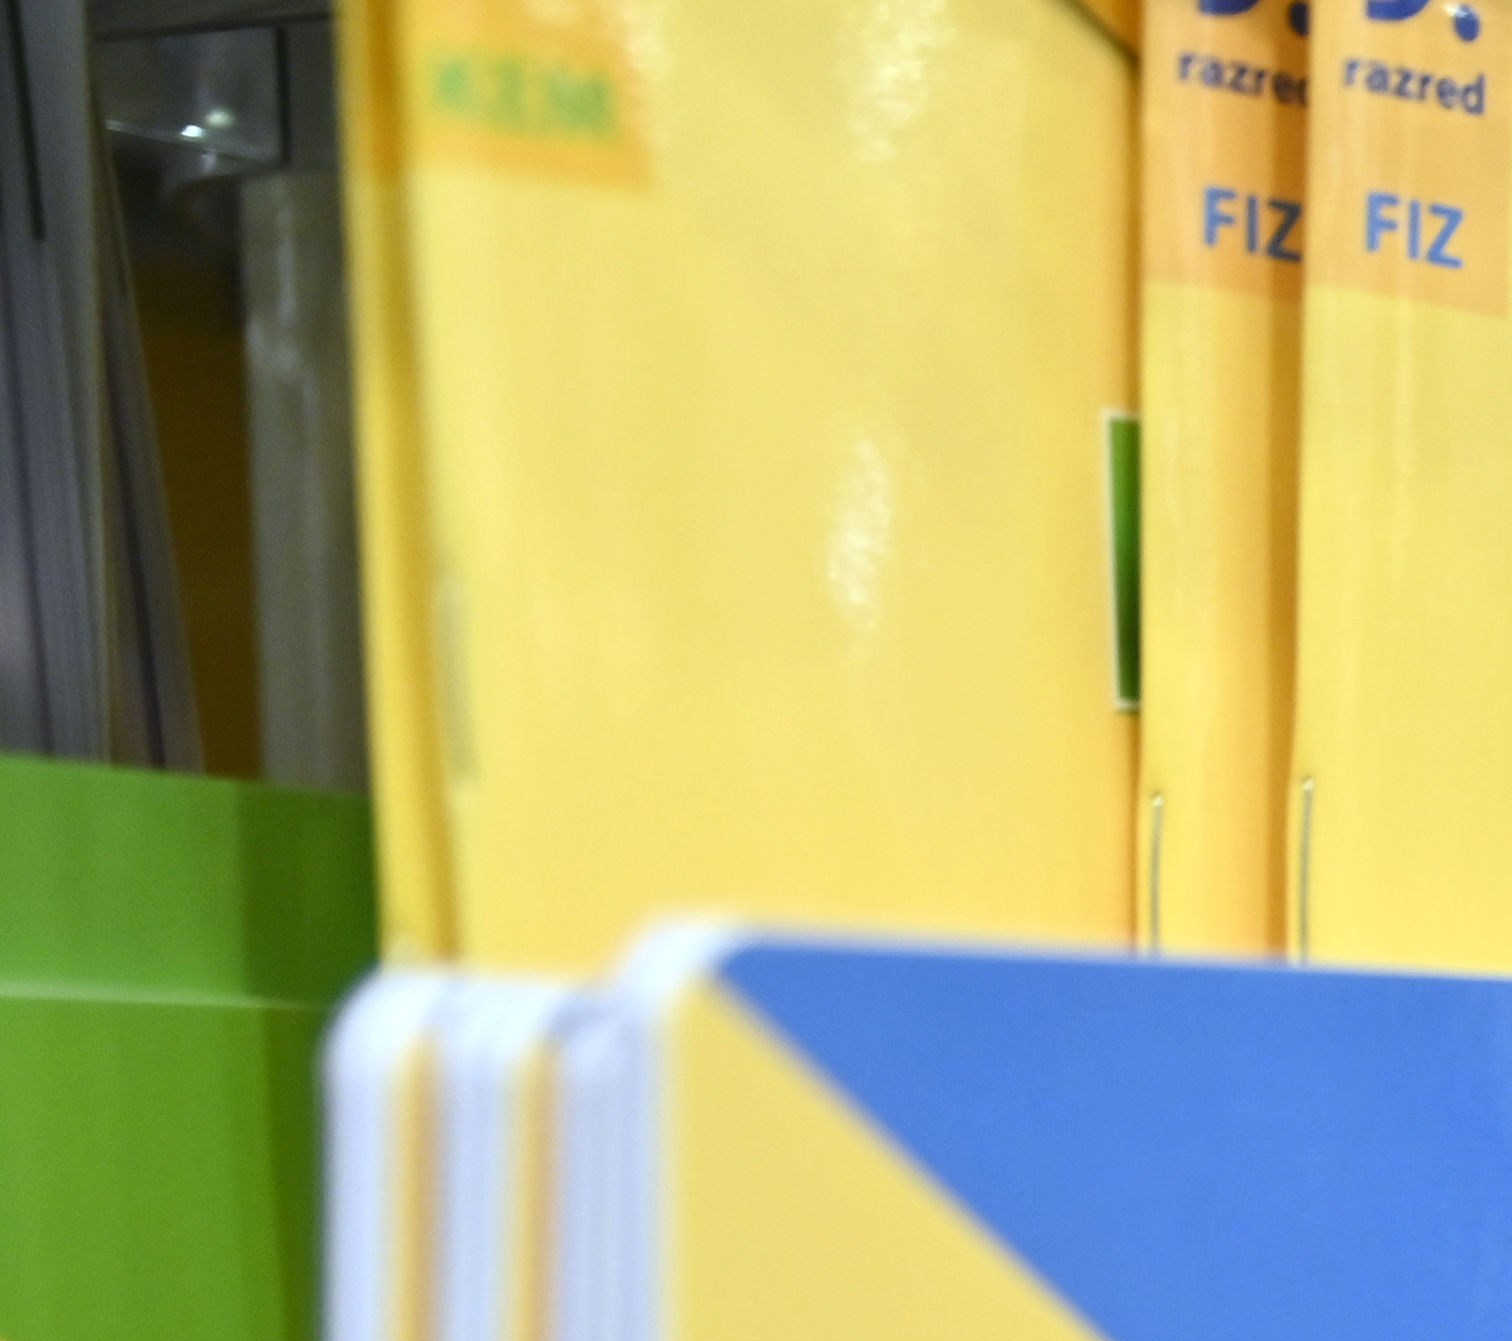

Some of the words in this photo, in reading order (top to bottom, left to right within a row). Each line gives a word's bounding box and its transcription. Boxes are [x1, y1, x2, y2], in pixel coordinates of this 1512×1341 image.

[1344, 57, 1486, 116] razred
[1203, 185, 1304, 263] FIZ
[1364, 190, 1465, 269] FIZ
